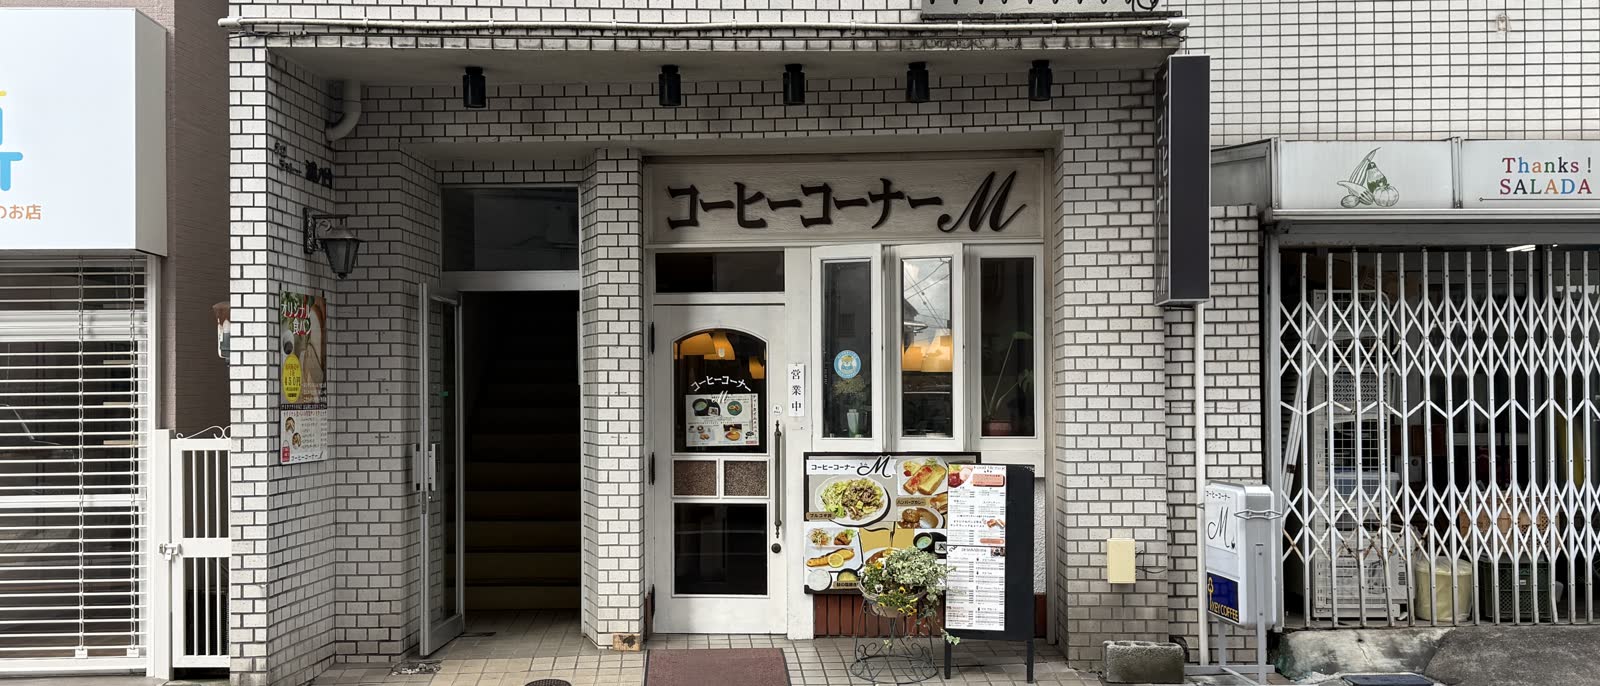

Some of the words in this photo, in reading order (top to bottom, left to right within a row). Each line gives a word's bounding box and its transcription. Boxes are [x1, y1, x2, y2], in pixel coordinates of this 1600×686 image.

[1499, 178, 1592, 195] SALADA
[667, 177, 944, 230] コーヒーコーナー
[937, 170, 1028, 233] M
[690, 375, 752, 392] コーヒーコーナー
[790, 368, 802, 412] 営業中
[811, 463, 856, 471] コーヒーコーナー
[856, 455, 892, 478] M
[1207, 506, 1231, 549] M
[1220, 604, 1239, 621] COFFEE
